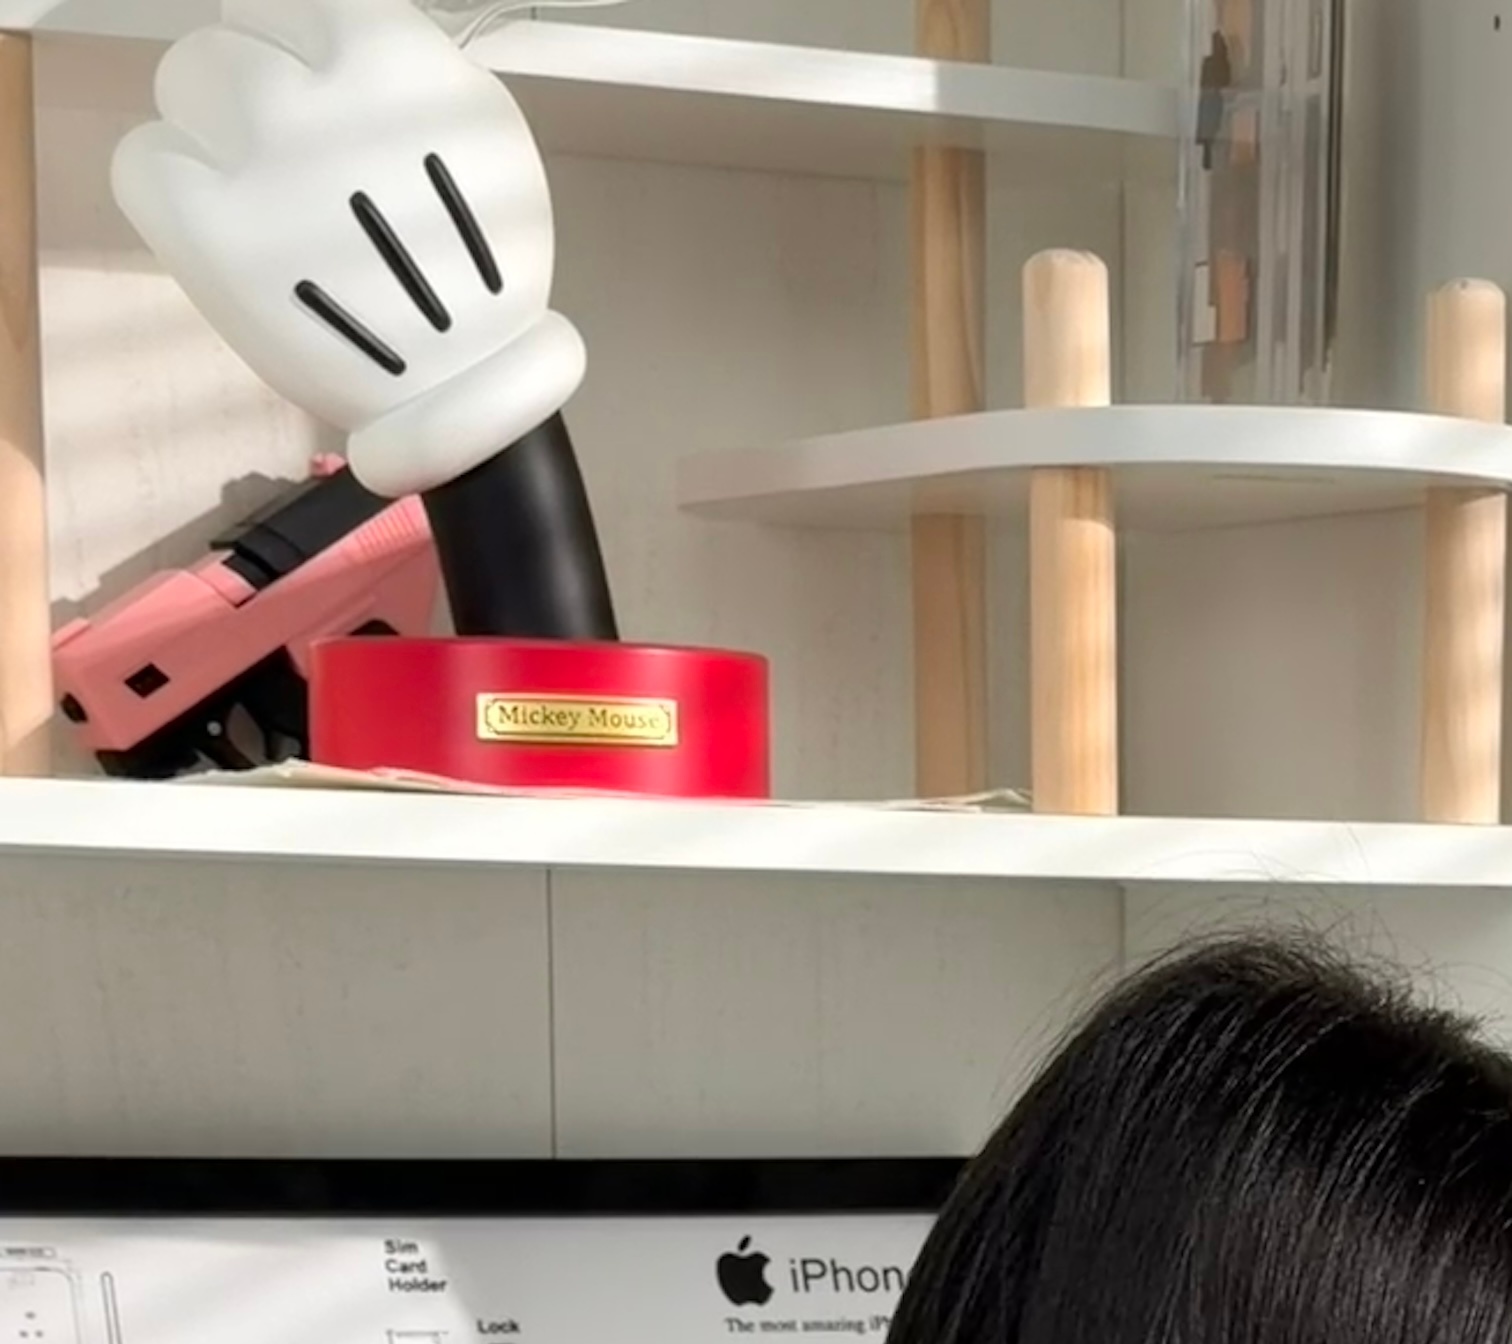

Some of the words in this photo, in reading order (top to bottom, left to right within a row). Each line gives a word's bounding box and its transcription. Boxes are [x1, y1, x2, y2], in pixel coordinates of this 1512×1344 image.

[499, 705, 581, 730] Mickey
[588, 707, 660, 729] Mouse
[385, 1240, 418, 1254] Sim
[386, 1259, 427, 1274] Card
[789, 1258, 905, 1293] iPhon
[389, 1278, 446, 1293] Holder
[477, 1320, 520, 1334] Lock
[725, 1318, 755, 1333] The
[802, 1317, 866, 1335] amazing
